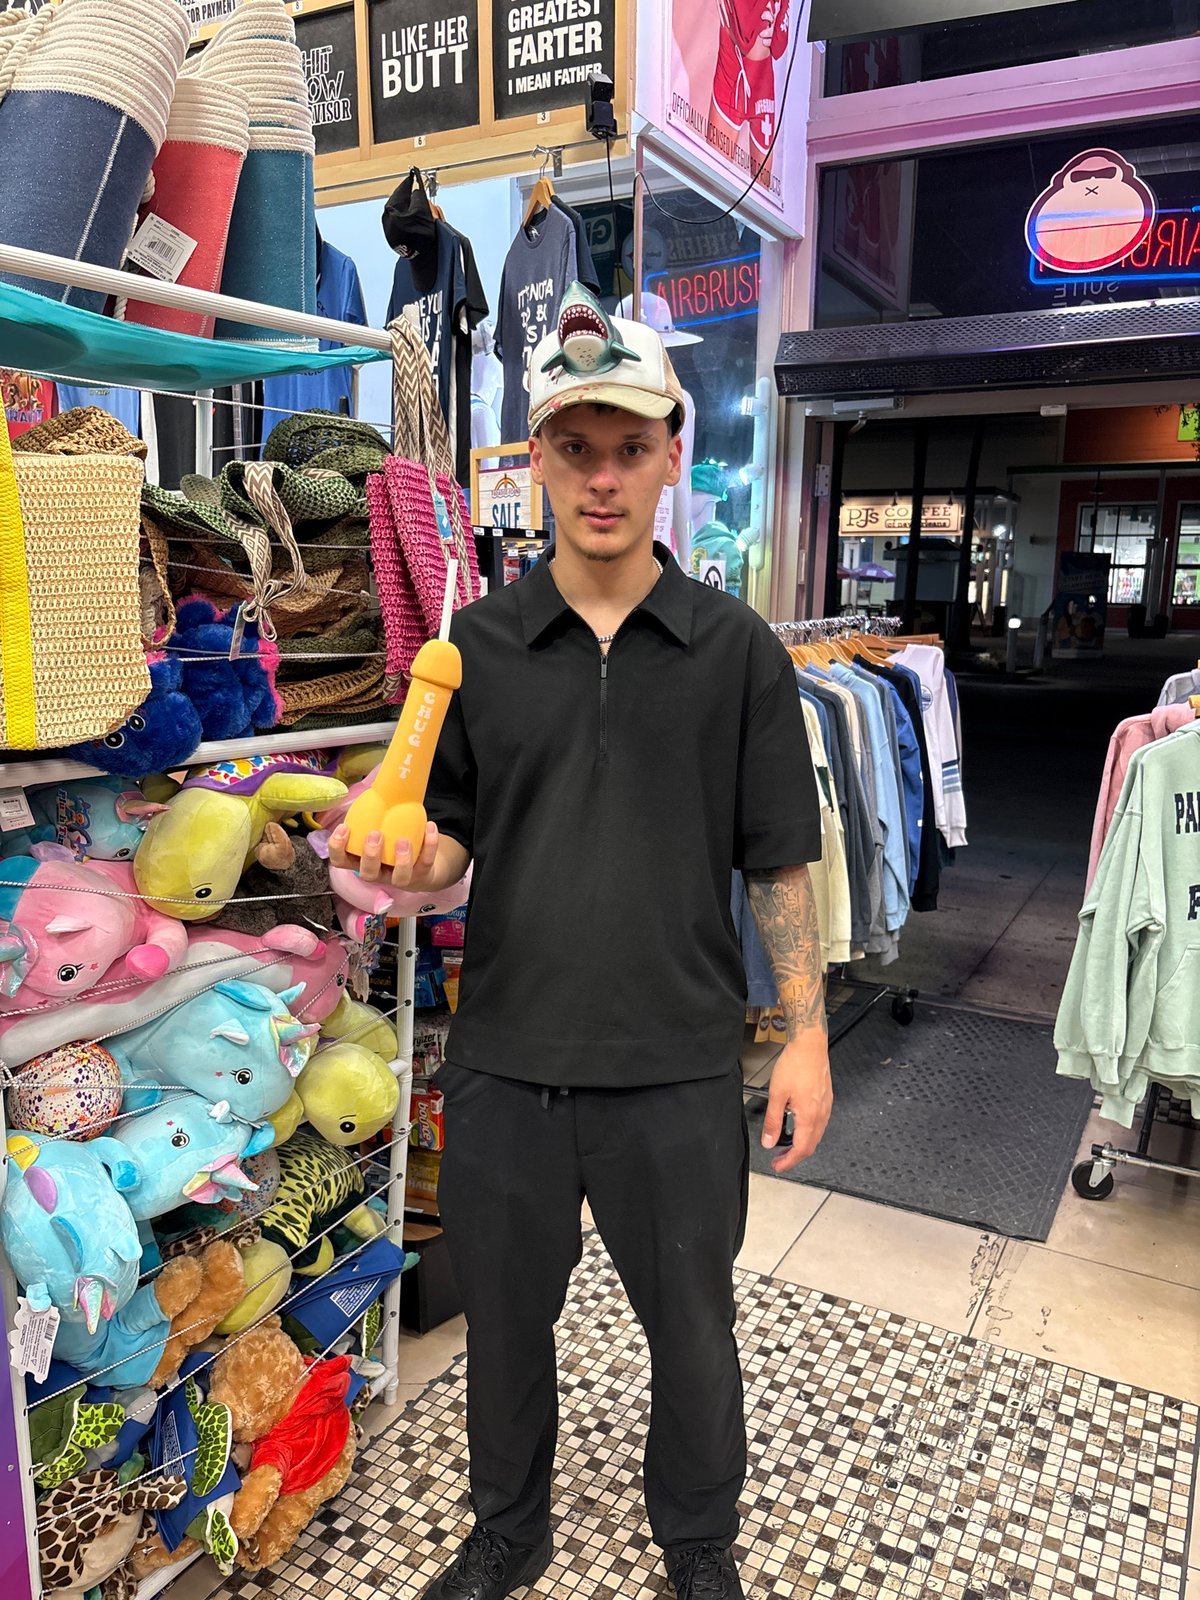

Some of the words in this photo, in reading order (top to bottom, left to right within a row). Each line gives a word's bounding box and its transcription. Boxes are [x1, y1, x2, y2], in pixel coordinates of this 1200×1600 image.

[202, 0, 236, 19] PAYMENT
[508, 0, 600, 33] GREATEST
[381, 33, 386, 59] I
[392, 23, 428, 57] LIKE
[434, 15, 468, 48] HER
[508, 20, 602, 69] FARTER
[301, 45, 332, 77] HIT
[382, 43, 468, 98] BUTT
[305, 71, 344, 103] OW
[508, 79, 513, 96] I
[515, 71, 551, 94] MEAN
[554, 62, 602, 87] FATHER
[541, 112, 546, 120] 3
[492, 501, 521, 528] SALE
[884, 506, 952, 517] COFEE
[407, 692, 436, 748] CHUG
[399, 753, 414, 779] IT
[418, 1102, 432, 1142] bounce
